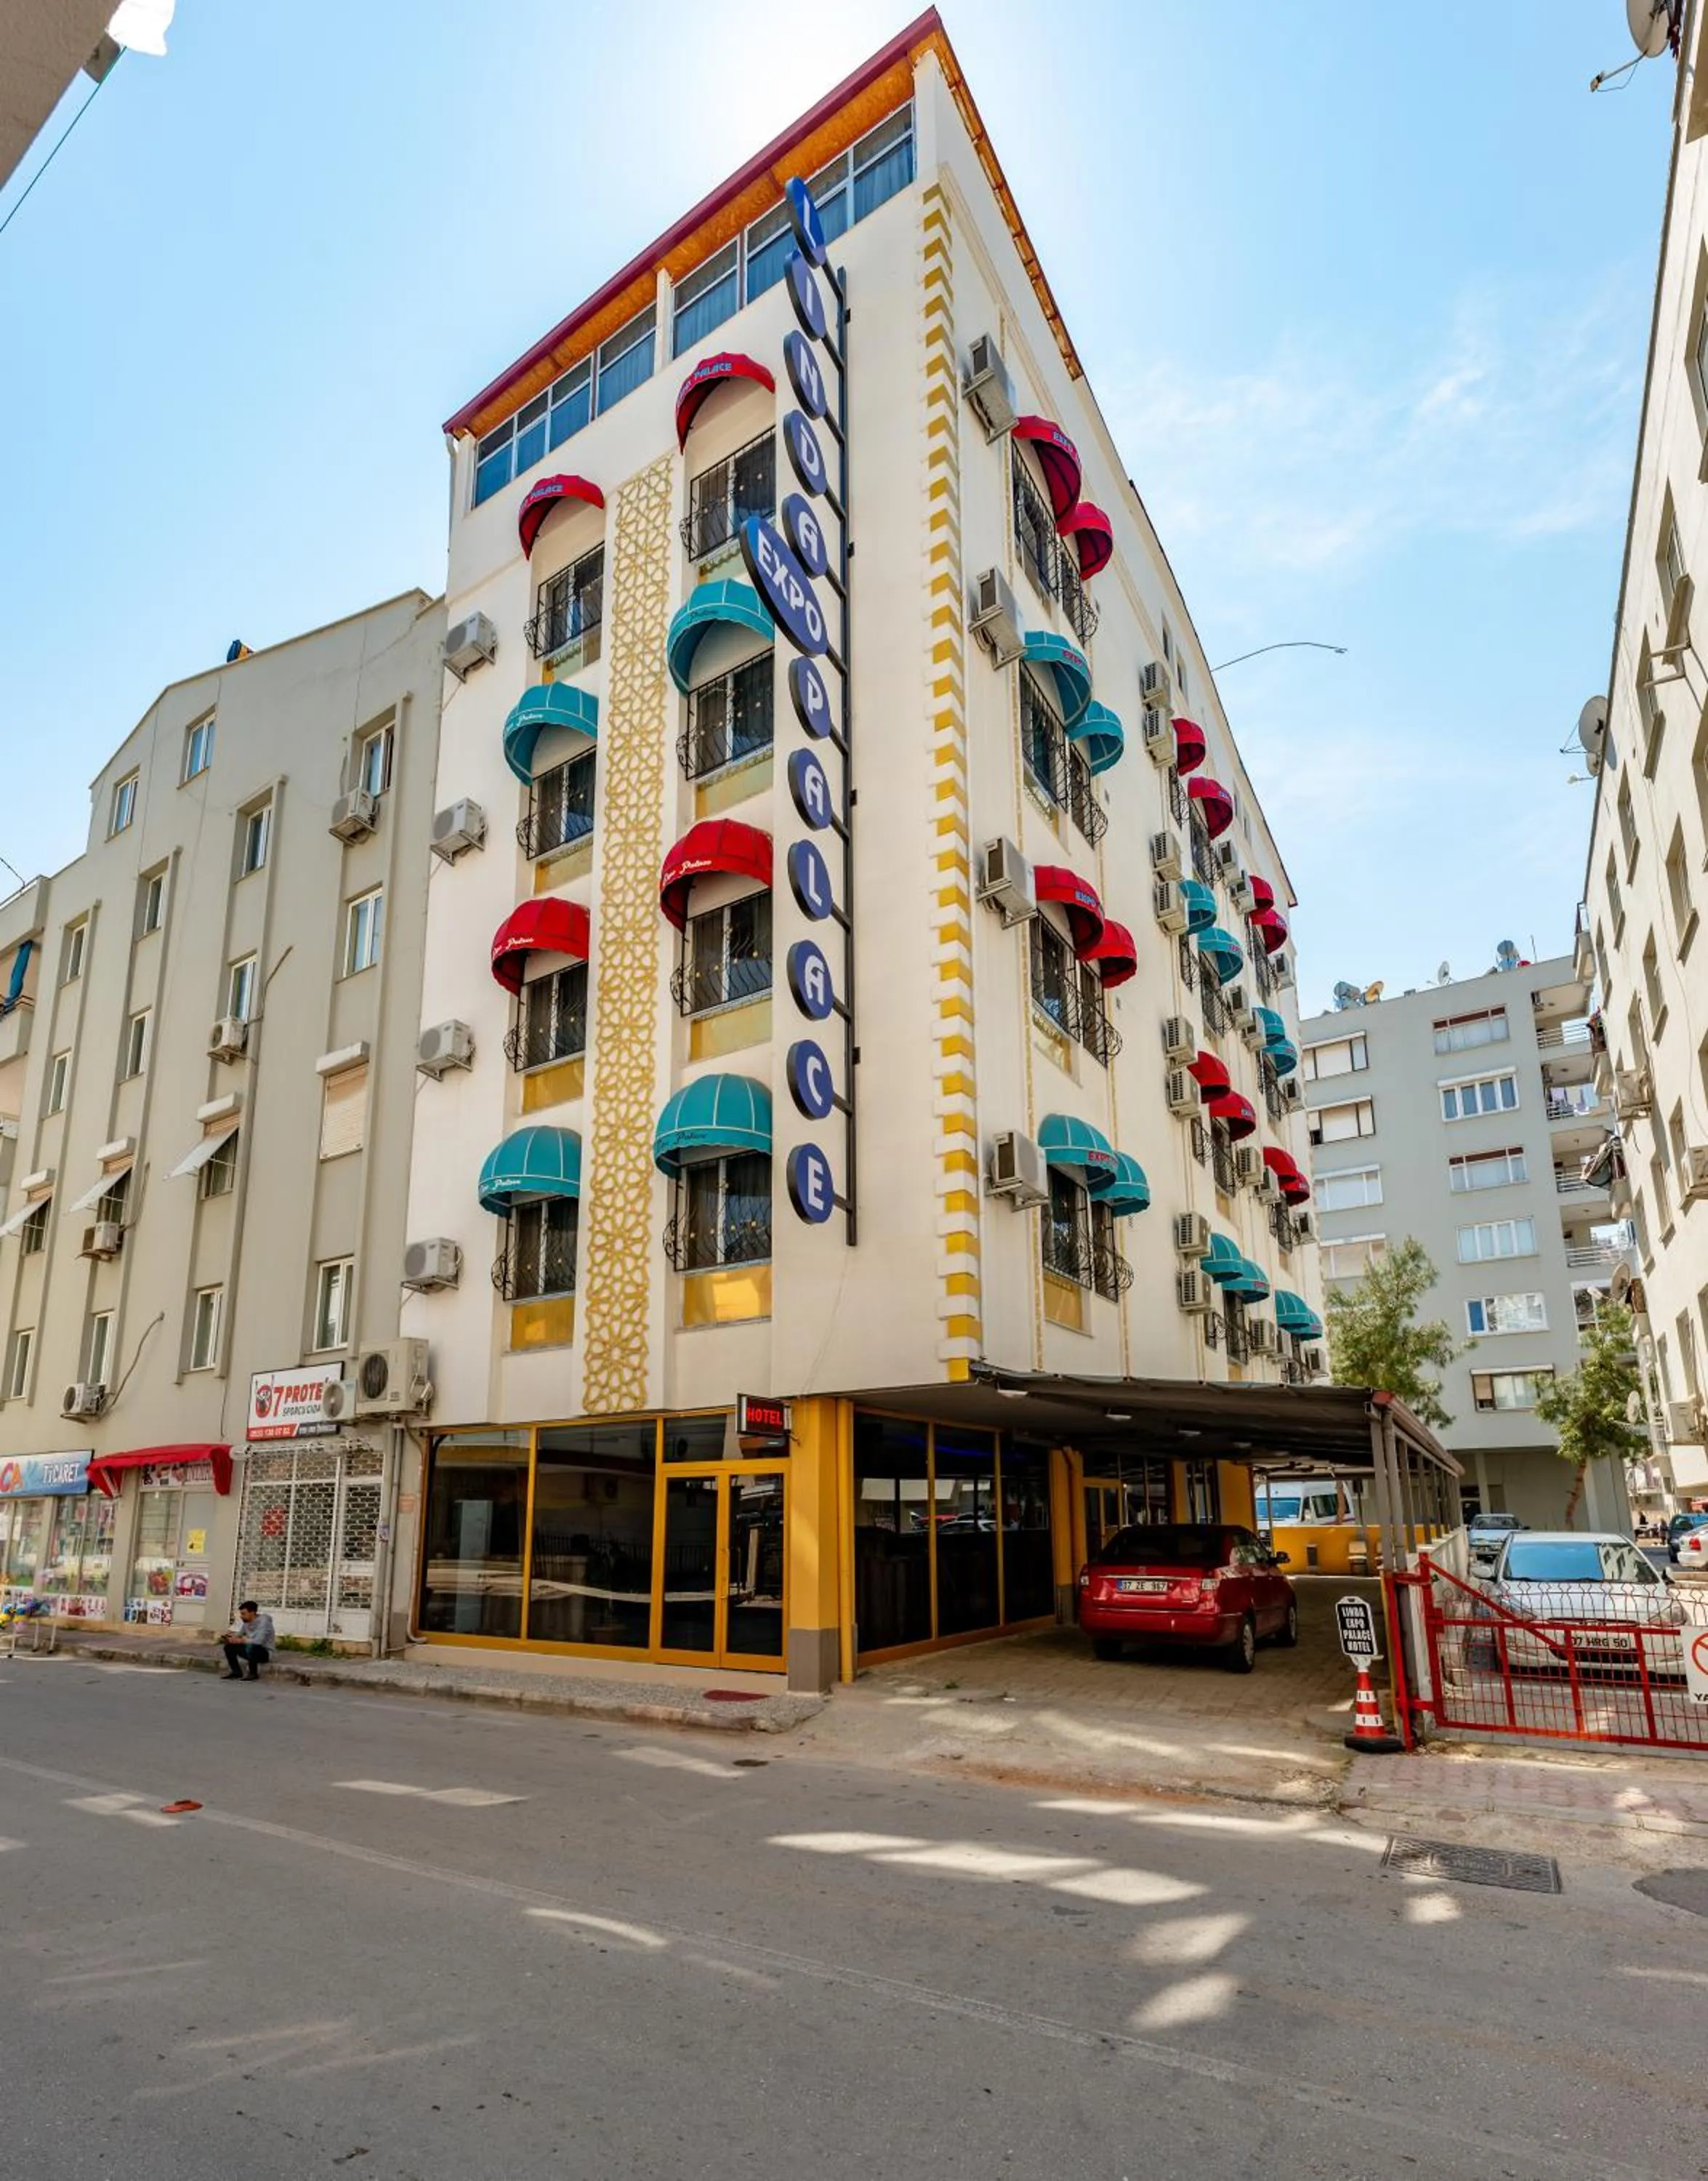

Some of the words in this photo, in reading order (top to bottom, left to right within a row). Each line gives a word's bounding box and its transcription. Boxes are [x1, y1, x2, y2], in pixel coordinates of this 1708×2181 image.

[757, 528, 823, 643] EXPO
[805, 669, 826, 1211] PALACE
[283, 1381, 324, 1405] PROTE
[746, 1407, 782, 1426] HOTEL
[1341, 1606, 1366, 1618] LINDA
[1345, 1618, 1365, 1629] EXPO
[1342, 1629, 1371, 1641] PALACE
[1347, 1641, 1371, 1652] HOTEL
[1614, 1638, 1627, 1648] 50
